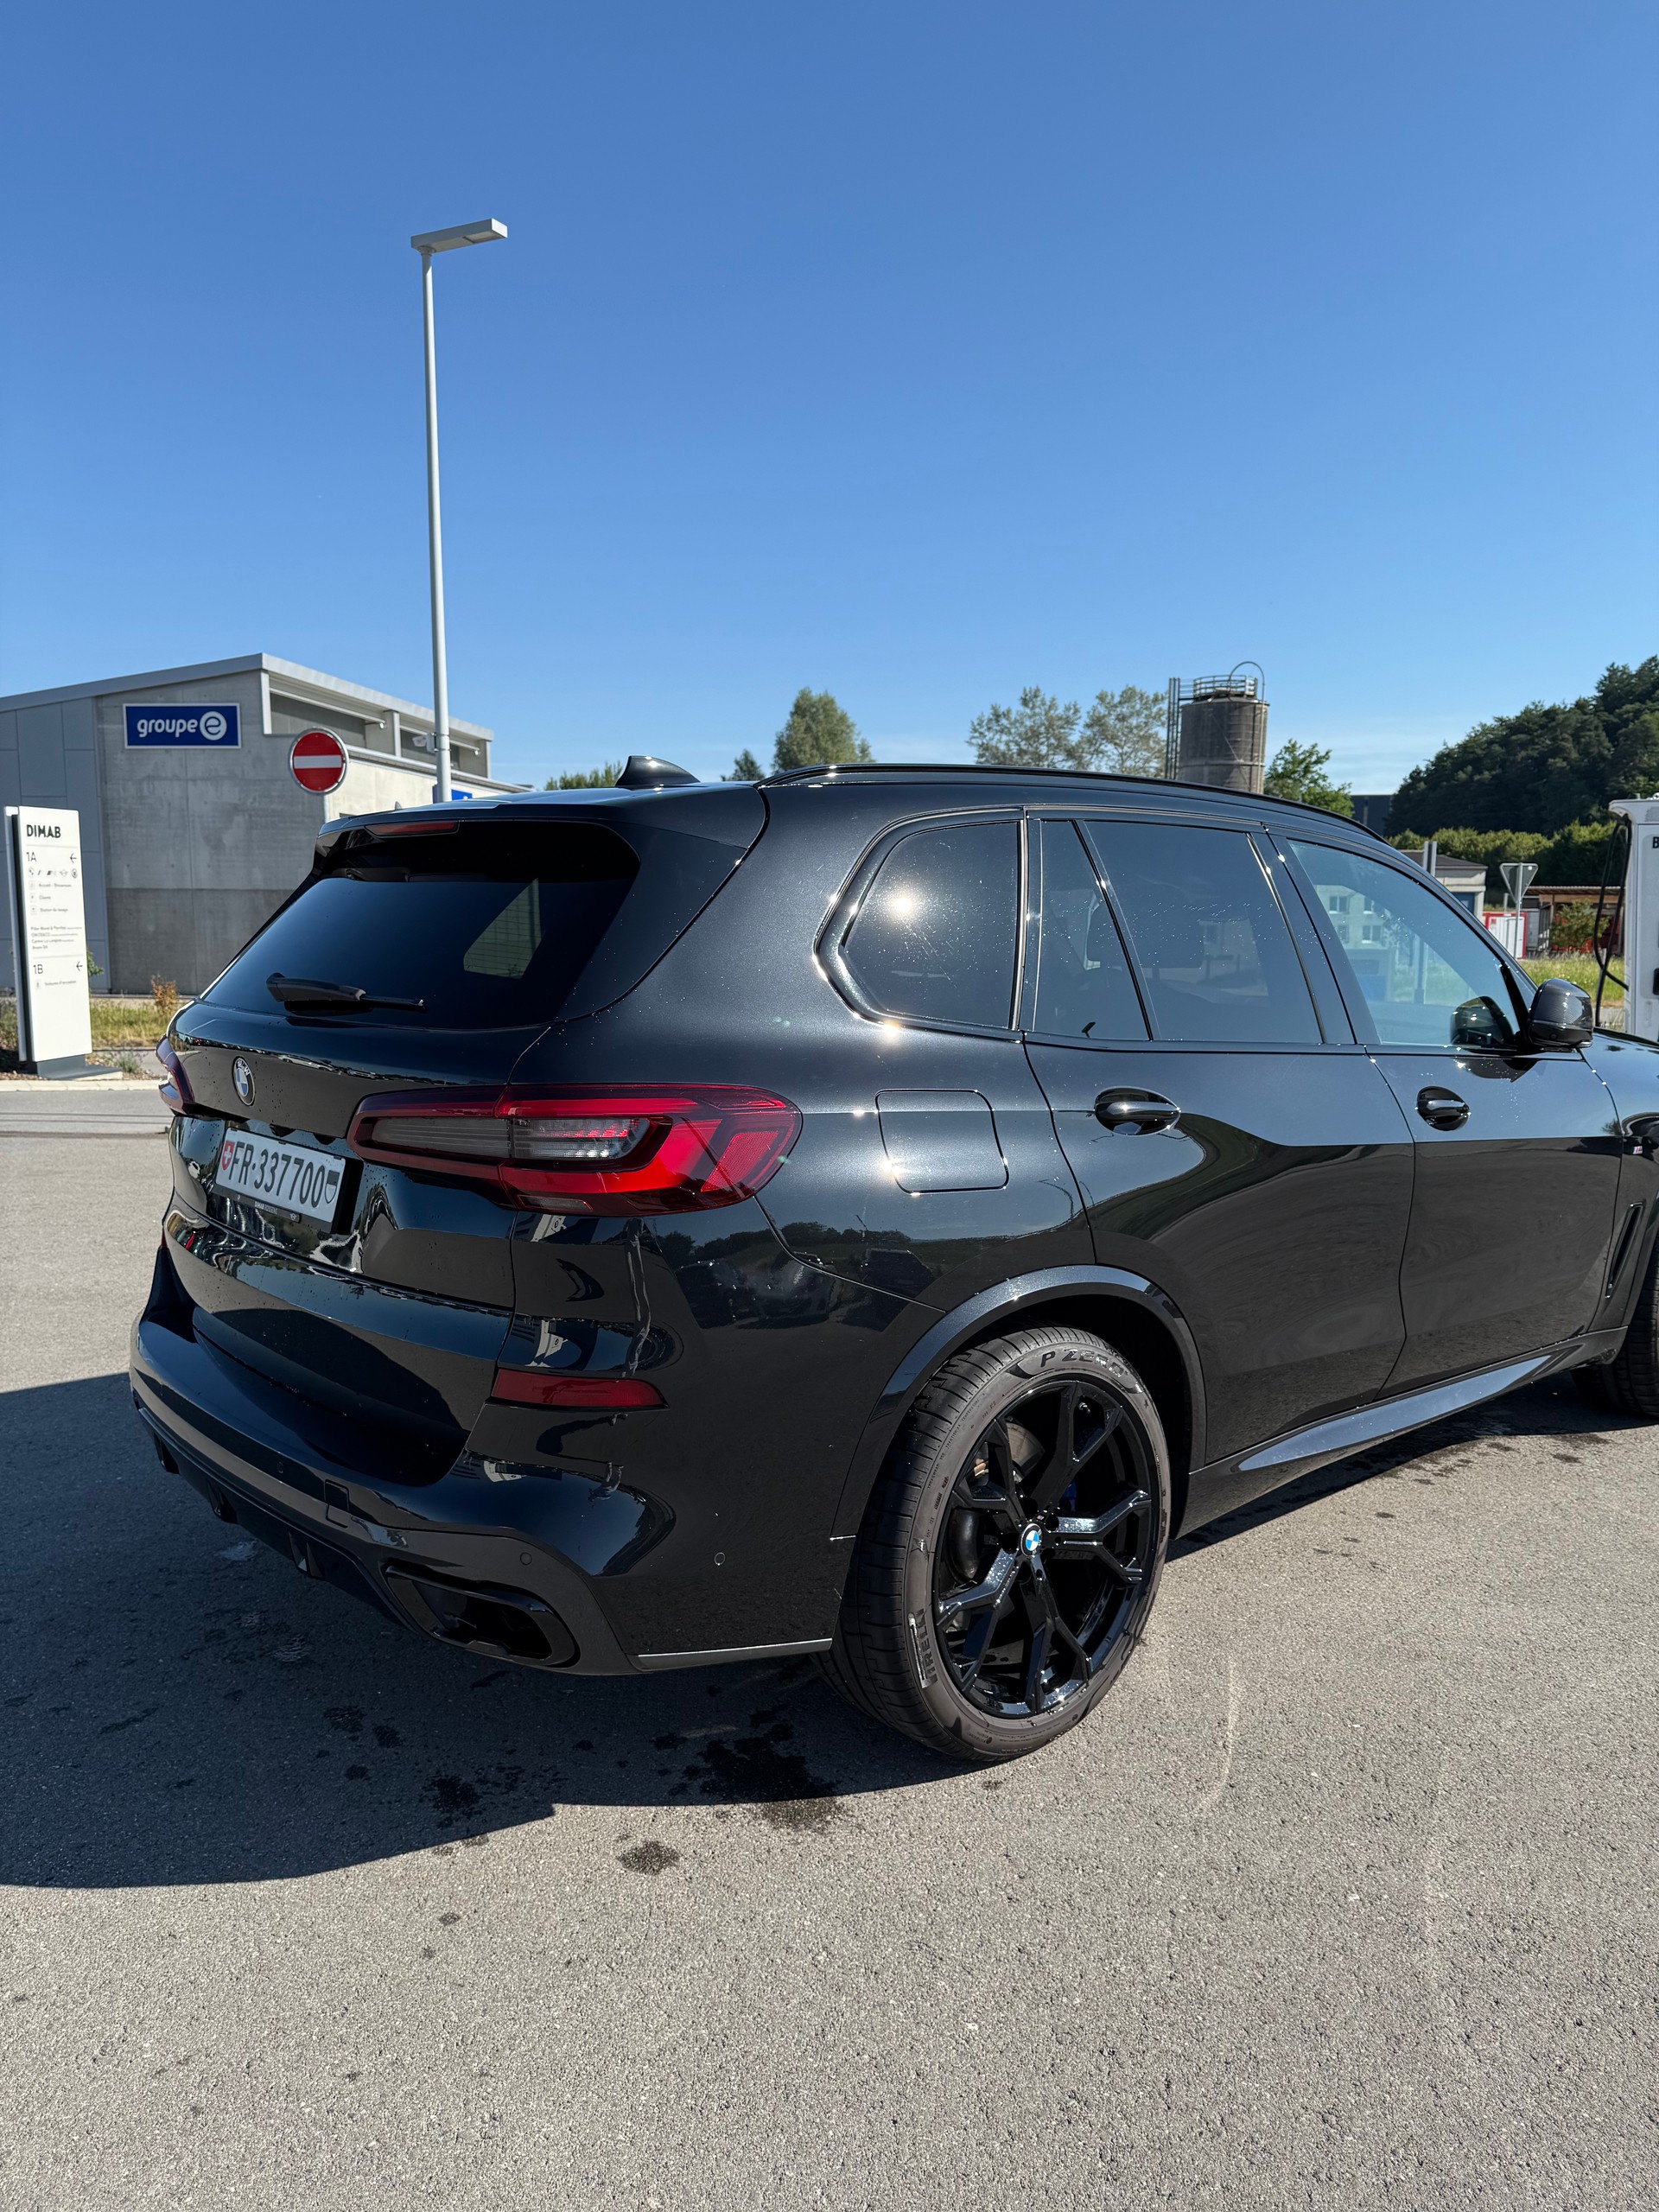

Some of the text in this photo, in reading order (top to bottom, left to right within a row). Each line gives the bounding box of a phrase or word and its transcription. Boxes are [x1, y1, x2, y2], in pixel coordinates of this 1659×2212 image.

[137, 719, 199, 738] groupe
[26, 824, 61, 838] DIMAB
[26, 851, 37, 862] 1A
[33, 963, 44, 975] 1B
[1039, 1348, 1124, 1378] P ZERO
[910, 1608, 938, 1687] PIRELLI
